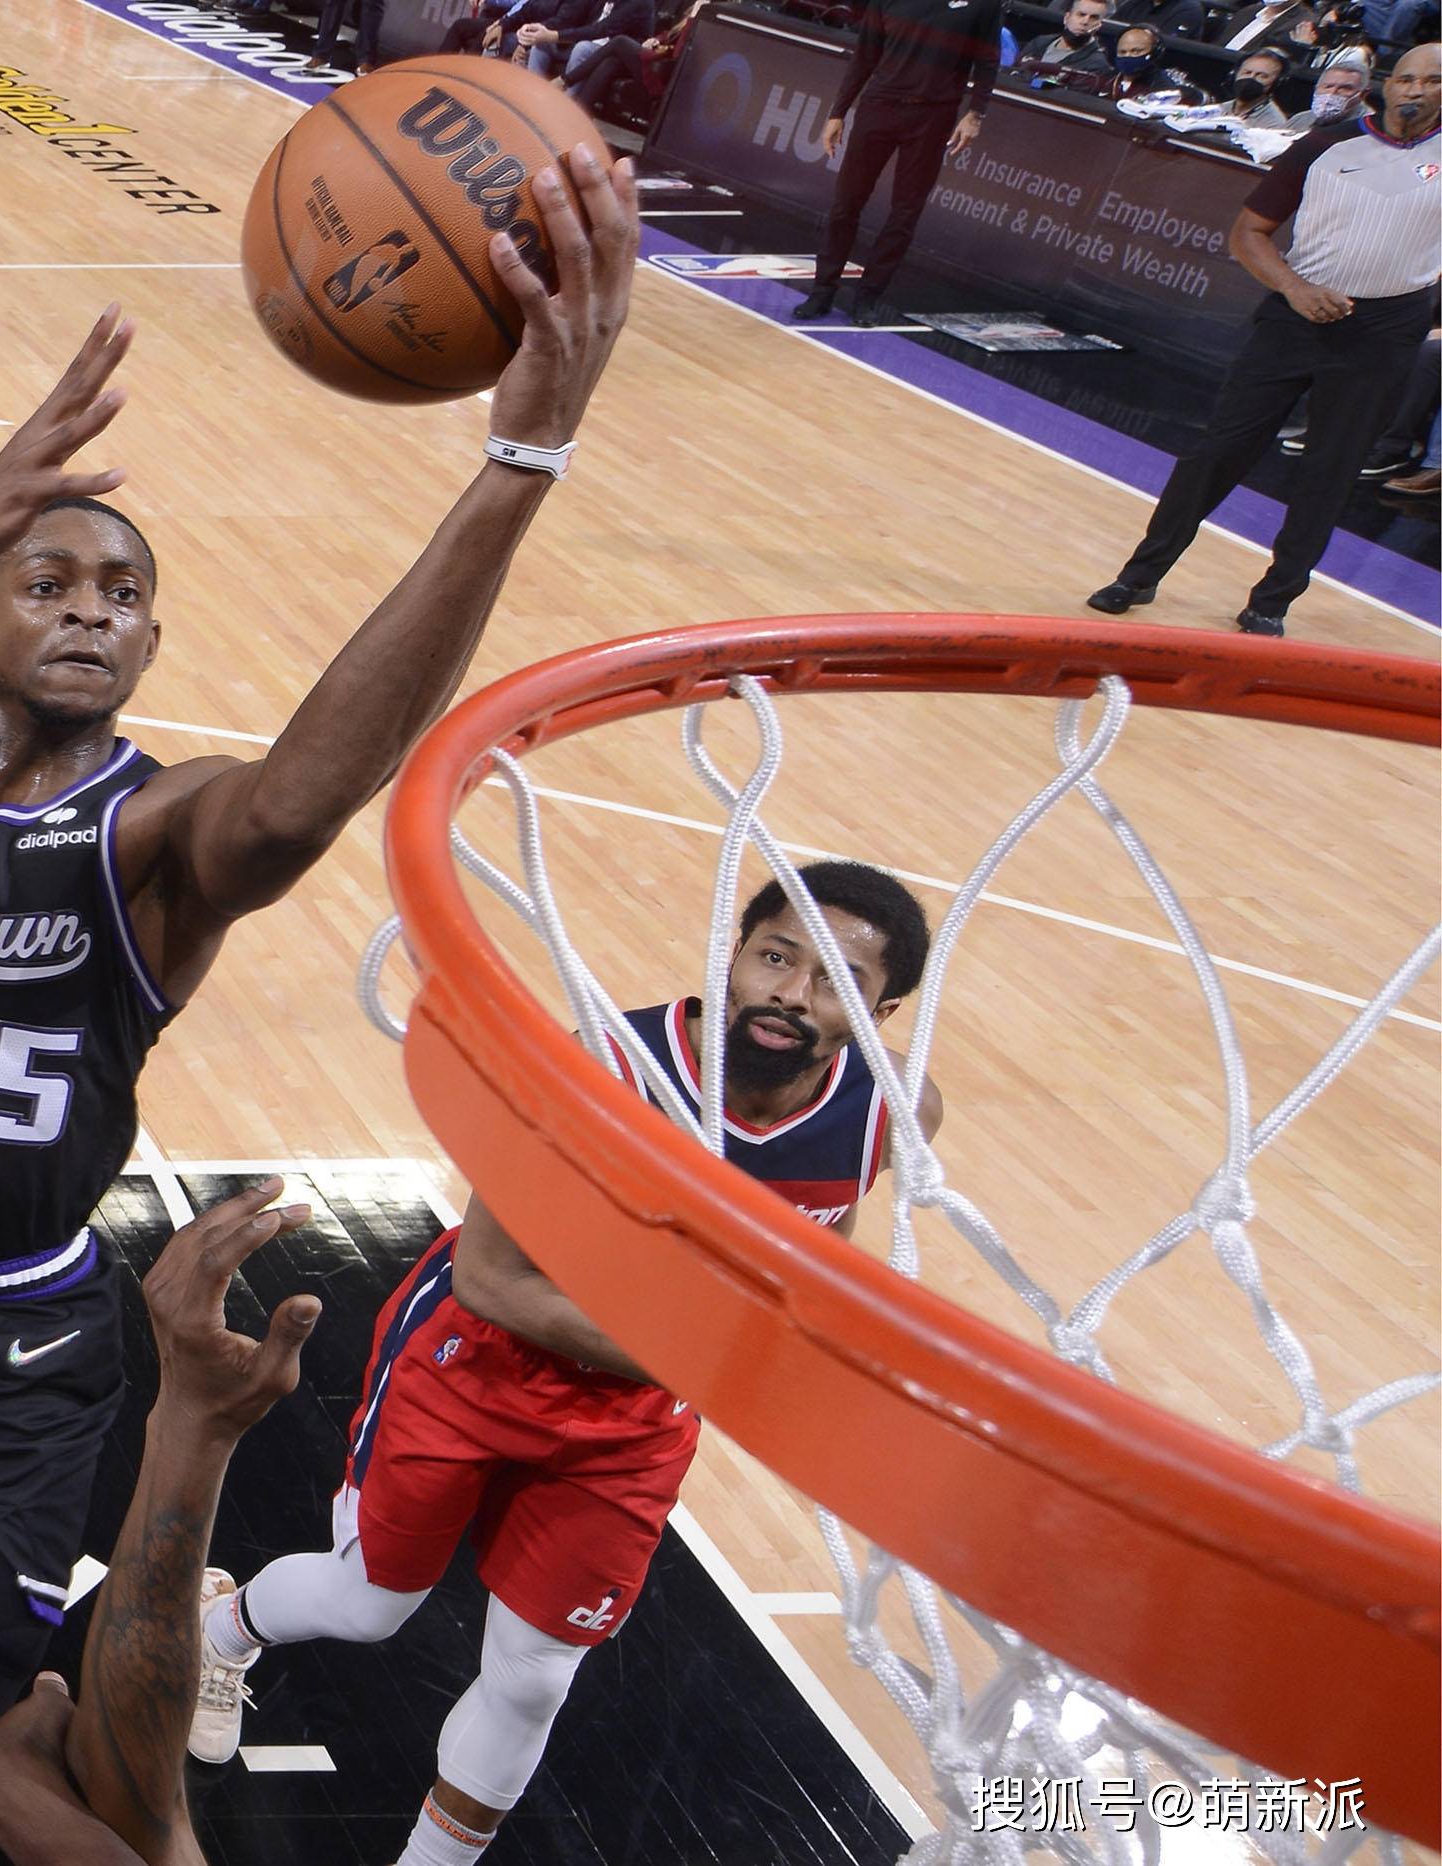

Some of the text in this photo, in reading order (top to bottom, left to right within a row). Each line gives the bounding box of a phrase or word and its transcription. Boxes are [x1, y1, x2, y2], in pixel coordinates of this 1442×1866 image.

[47, 138, 221, 214] CENTER
[973, 152, 1083, 208] Insurance
[1098, 190, 1225, 253] Employee
[1010, 208, 1029, 234] &
[1032, 215, 1114, 264] Private
[1121, 243, 1210, 298] Wealth
[17, 825, 97, 850] dialpad
